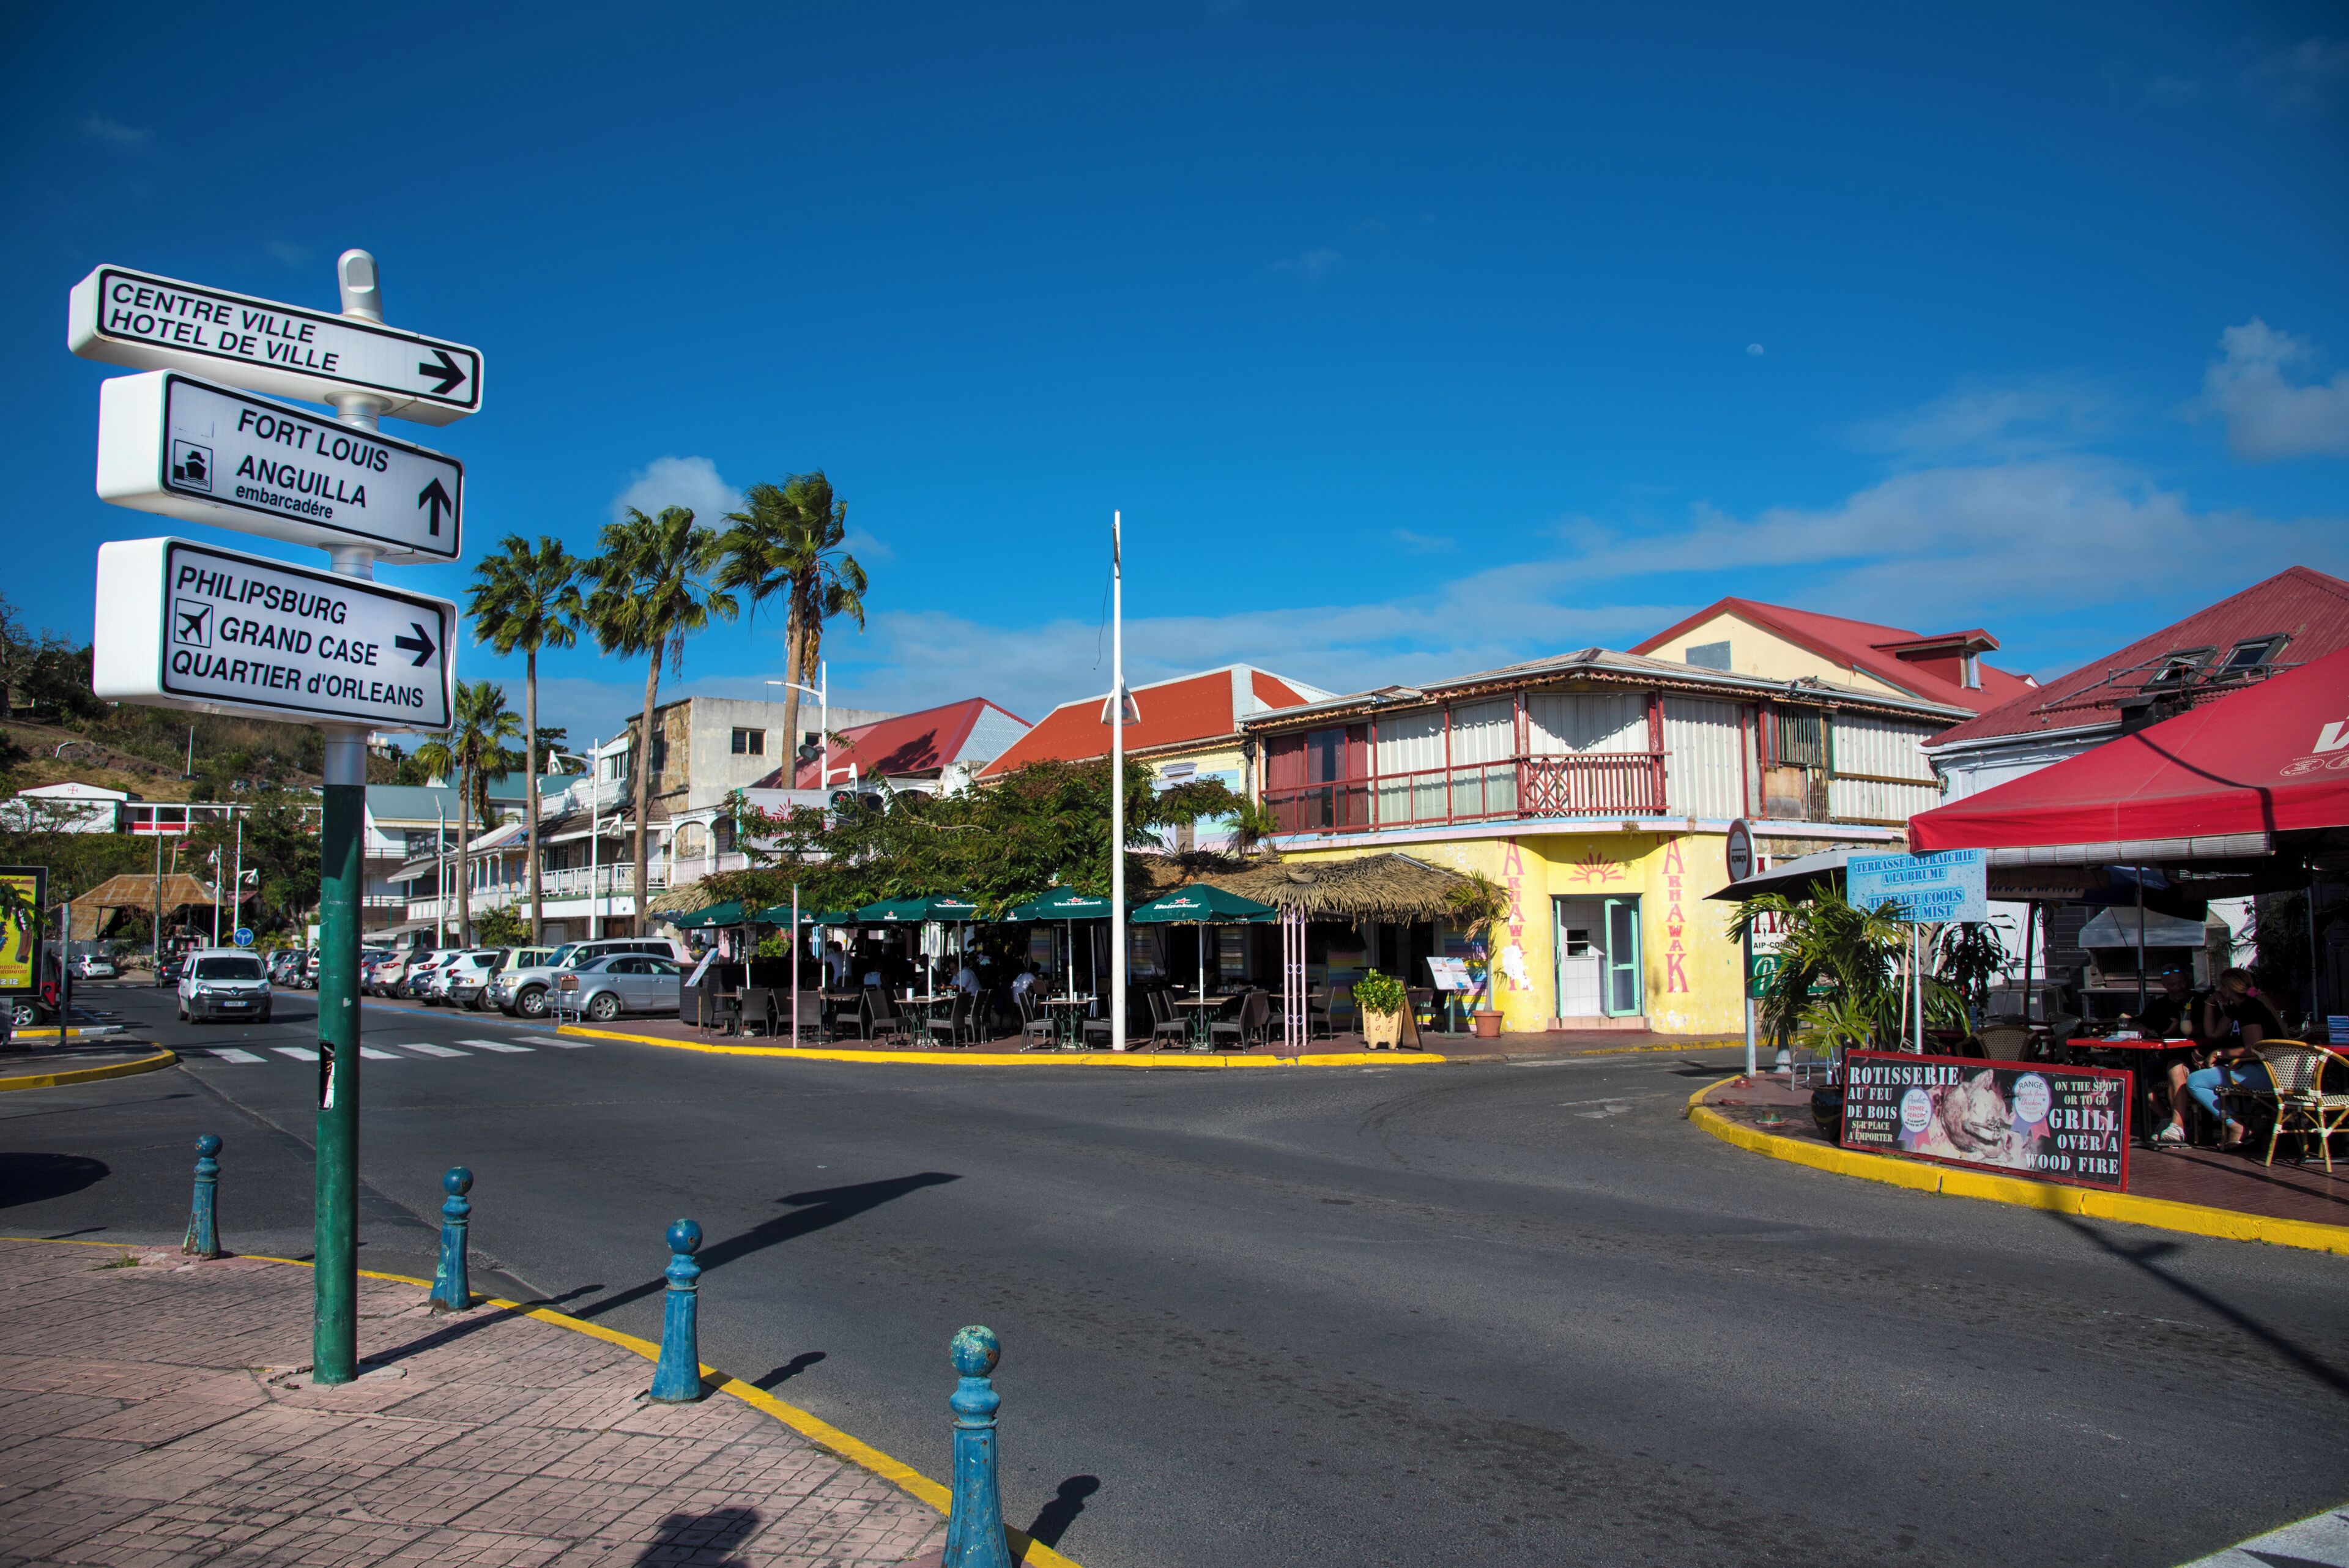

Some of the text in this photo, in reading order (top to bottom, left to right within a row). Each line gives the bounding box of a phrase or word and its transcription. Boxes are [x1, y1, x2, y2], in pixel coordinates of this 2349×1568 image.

[113, 283, 316, 343] CENTRE VILLE
[110, 308, 339, 372] HOTEL DE VILLE
[237, 409, 389, 472] FORT LOUIS
[236, 455, 366, 508] ANGUILLA
[236, 485, 333, 518] embarcadére
[177, 565, 347, 624] PHILIPSBURG
[220, 617, 379, 666] GRAND CASE
[172, 650, 423, 708] QUARTIER d'ORLEANS
[1856, 858, 1905, 873] TERRASSE
[1883, 868, 1945, 884] A LA BRUME
[1924, 889, 1962, 904] COOLS
[1923, 904, 1953, 918] MIST
[1849, 1066, 1959, 1085] ROTISSERIE
[2019, 1080, 2044, 1090] RANGE
[2055, 1081, 2118, 1092] ON THE SPOT
[1848, 1087, 1893, 1101] AU FEU
[1907, 1094, 1929, 1105] Poulet
[2064, 1095, 2109, 1105] OR TO GO
[1847, 1105, 1897, 1120] DE BOIS
[2049, 1108, 2118, 1131] GRILL
[1852, 1120, 1890, 1131] SUR PLACE
[1848, 1131, 1893, 1142] A EMPORTER
[2057, 1134, 2118, 1152] OVER A
[2025, 1153, 2118, 1175] WOOD FIRE
